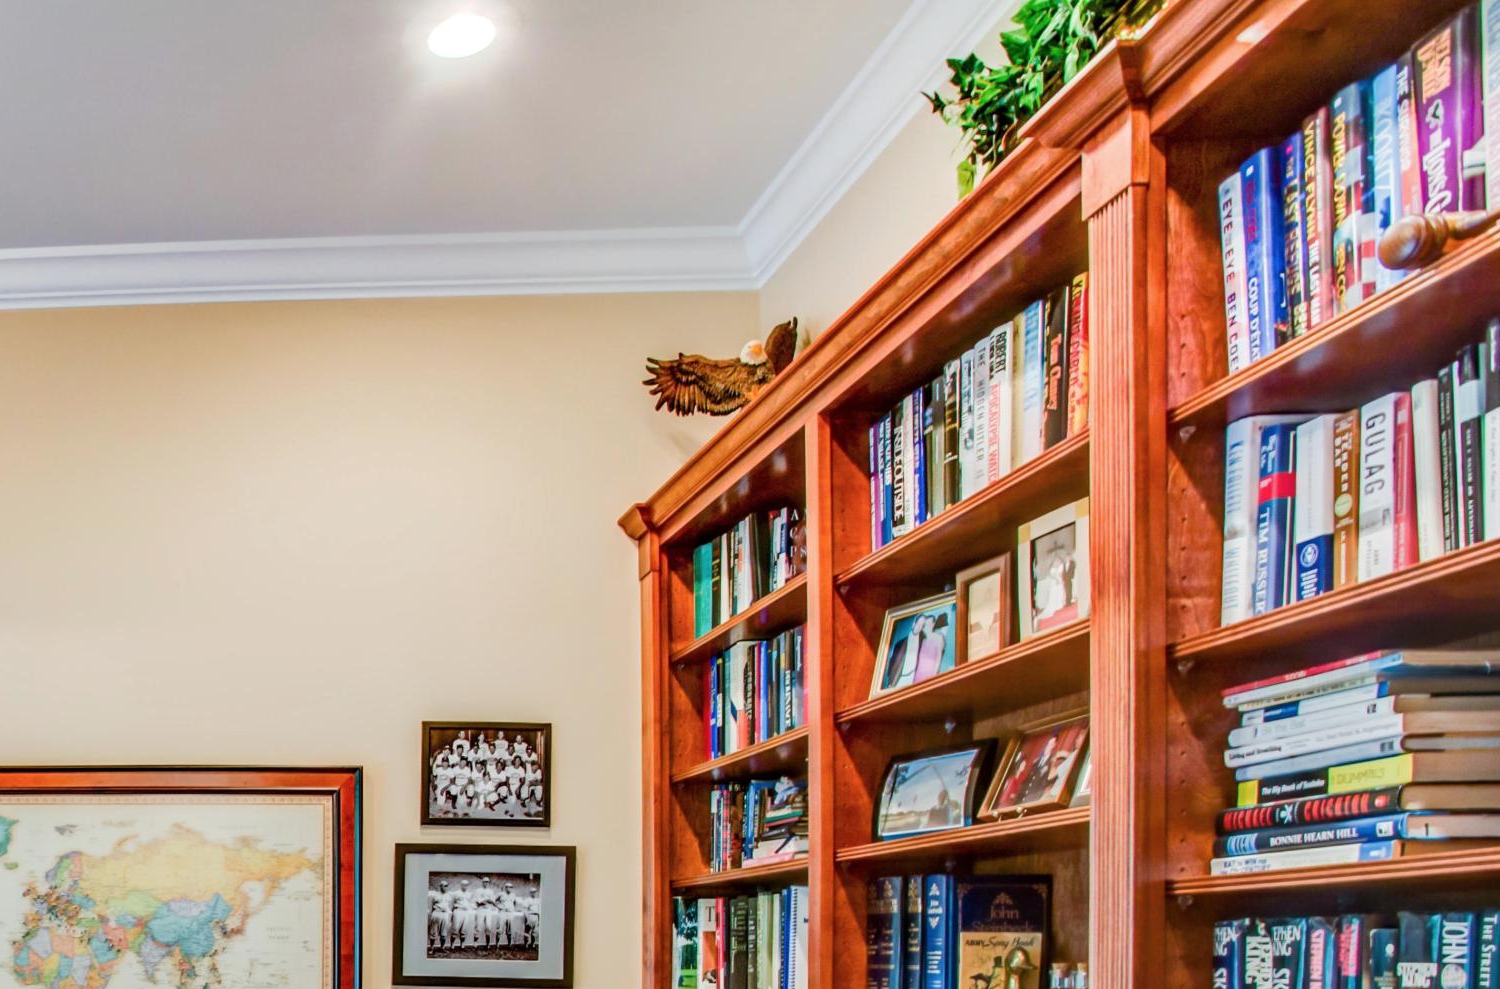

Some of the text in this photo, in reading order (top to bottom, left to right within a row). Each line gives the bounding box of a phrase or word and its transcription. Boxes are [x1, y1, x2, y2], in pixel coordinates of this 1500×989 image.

[1303, 121, 1318, 242] VINCE FLYNN
[1222, 197, 1233, 235] EYE
[1224, 248, 1236, 284] EYE
[1227, 292, 1237, 328] BEN
[1248, 276, 1261, 318] COUP
[977, 346, 986, 368] THE
[996, 330, 1007, 377] ROBERT
[1364, 412, 1386, 497] GULAG
[1258, 507, 1271, 544] TIM
[1269, 827, 1359, 847] BONNIE HEARN HILL
[990, 905, 1020, 921] John
[1484, 914, 1498, 941] THE
[1245, 936, 1258, 985] KING
[1309, 929, 1325, 979] STEPHEN
[1441, 921, 1468, 964] JOHN
[1479, 943, 1496, 988] STREET
